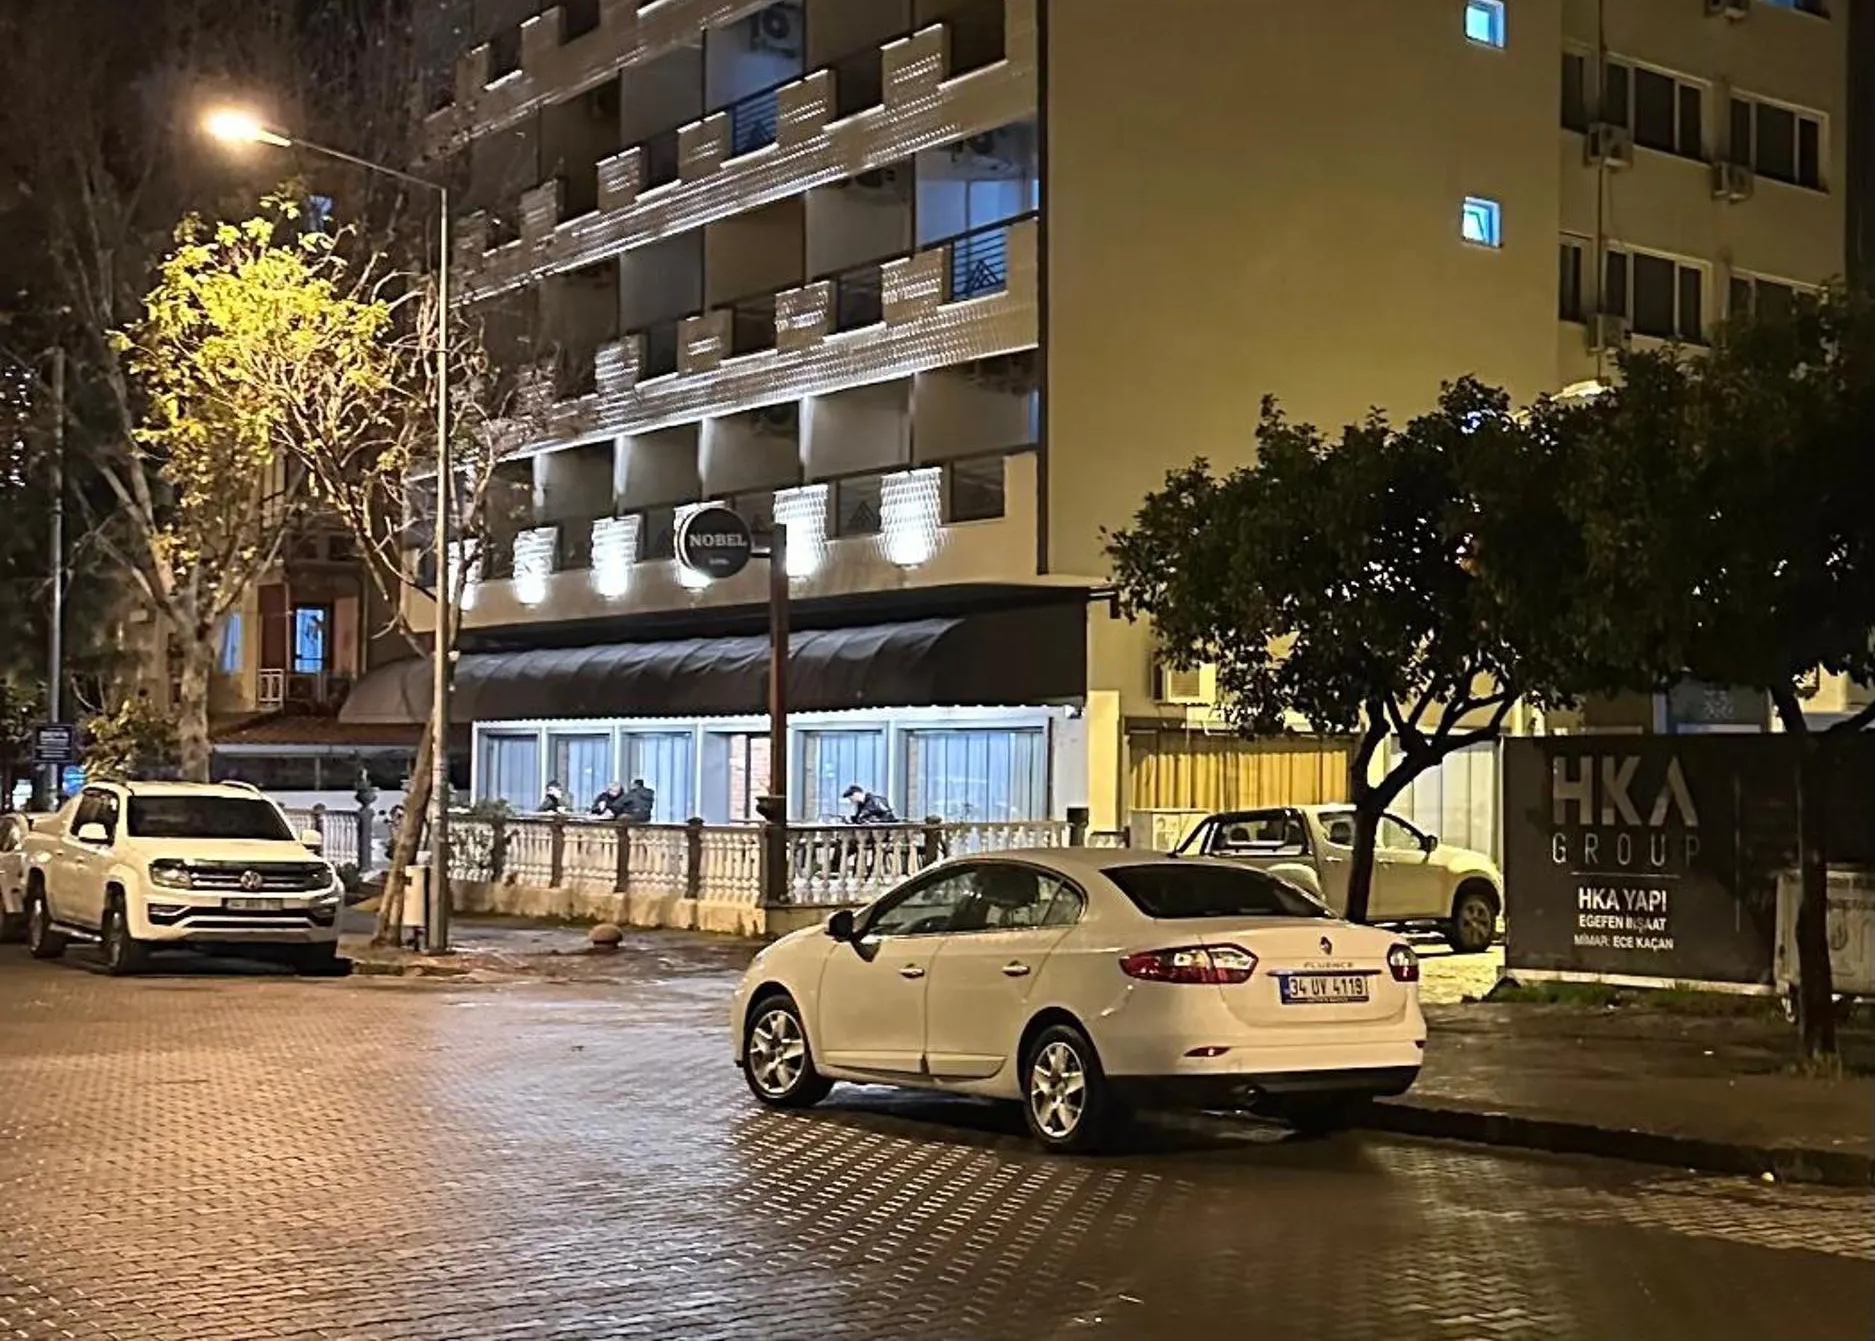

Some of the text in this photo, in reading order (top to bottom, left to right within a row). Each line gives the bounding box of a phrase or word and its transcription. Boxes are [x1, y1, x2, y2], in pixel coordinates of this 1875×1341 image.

[689, 534, 748, 547] NOBEL
[1552, 755, 1699, 827] HKA
[1552, 832, 1700, 867] GROUP
[1578, 887, 1667, 912] HKA YAPI
[1579, 913, 1624, 929] EGEFEN
[1613, 935, 1634, 949] ECE
[1636, 937, 1674, 952] KAÇAN
[1290, 978, 1306, 995] 34
[1332, 977, 1363, 995] 4119
